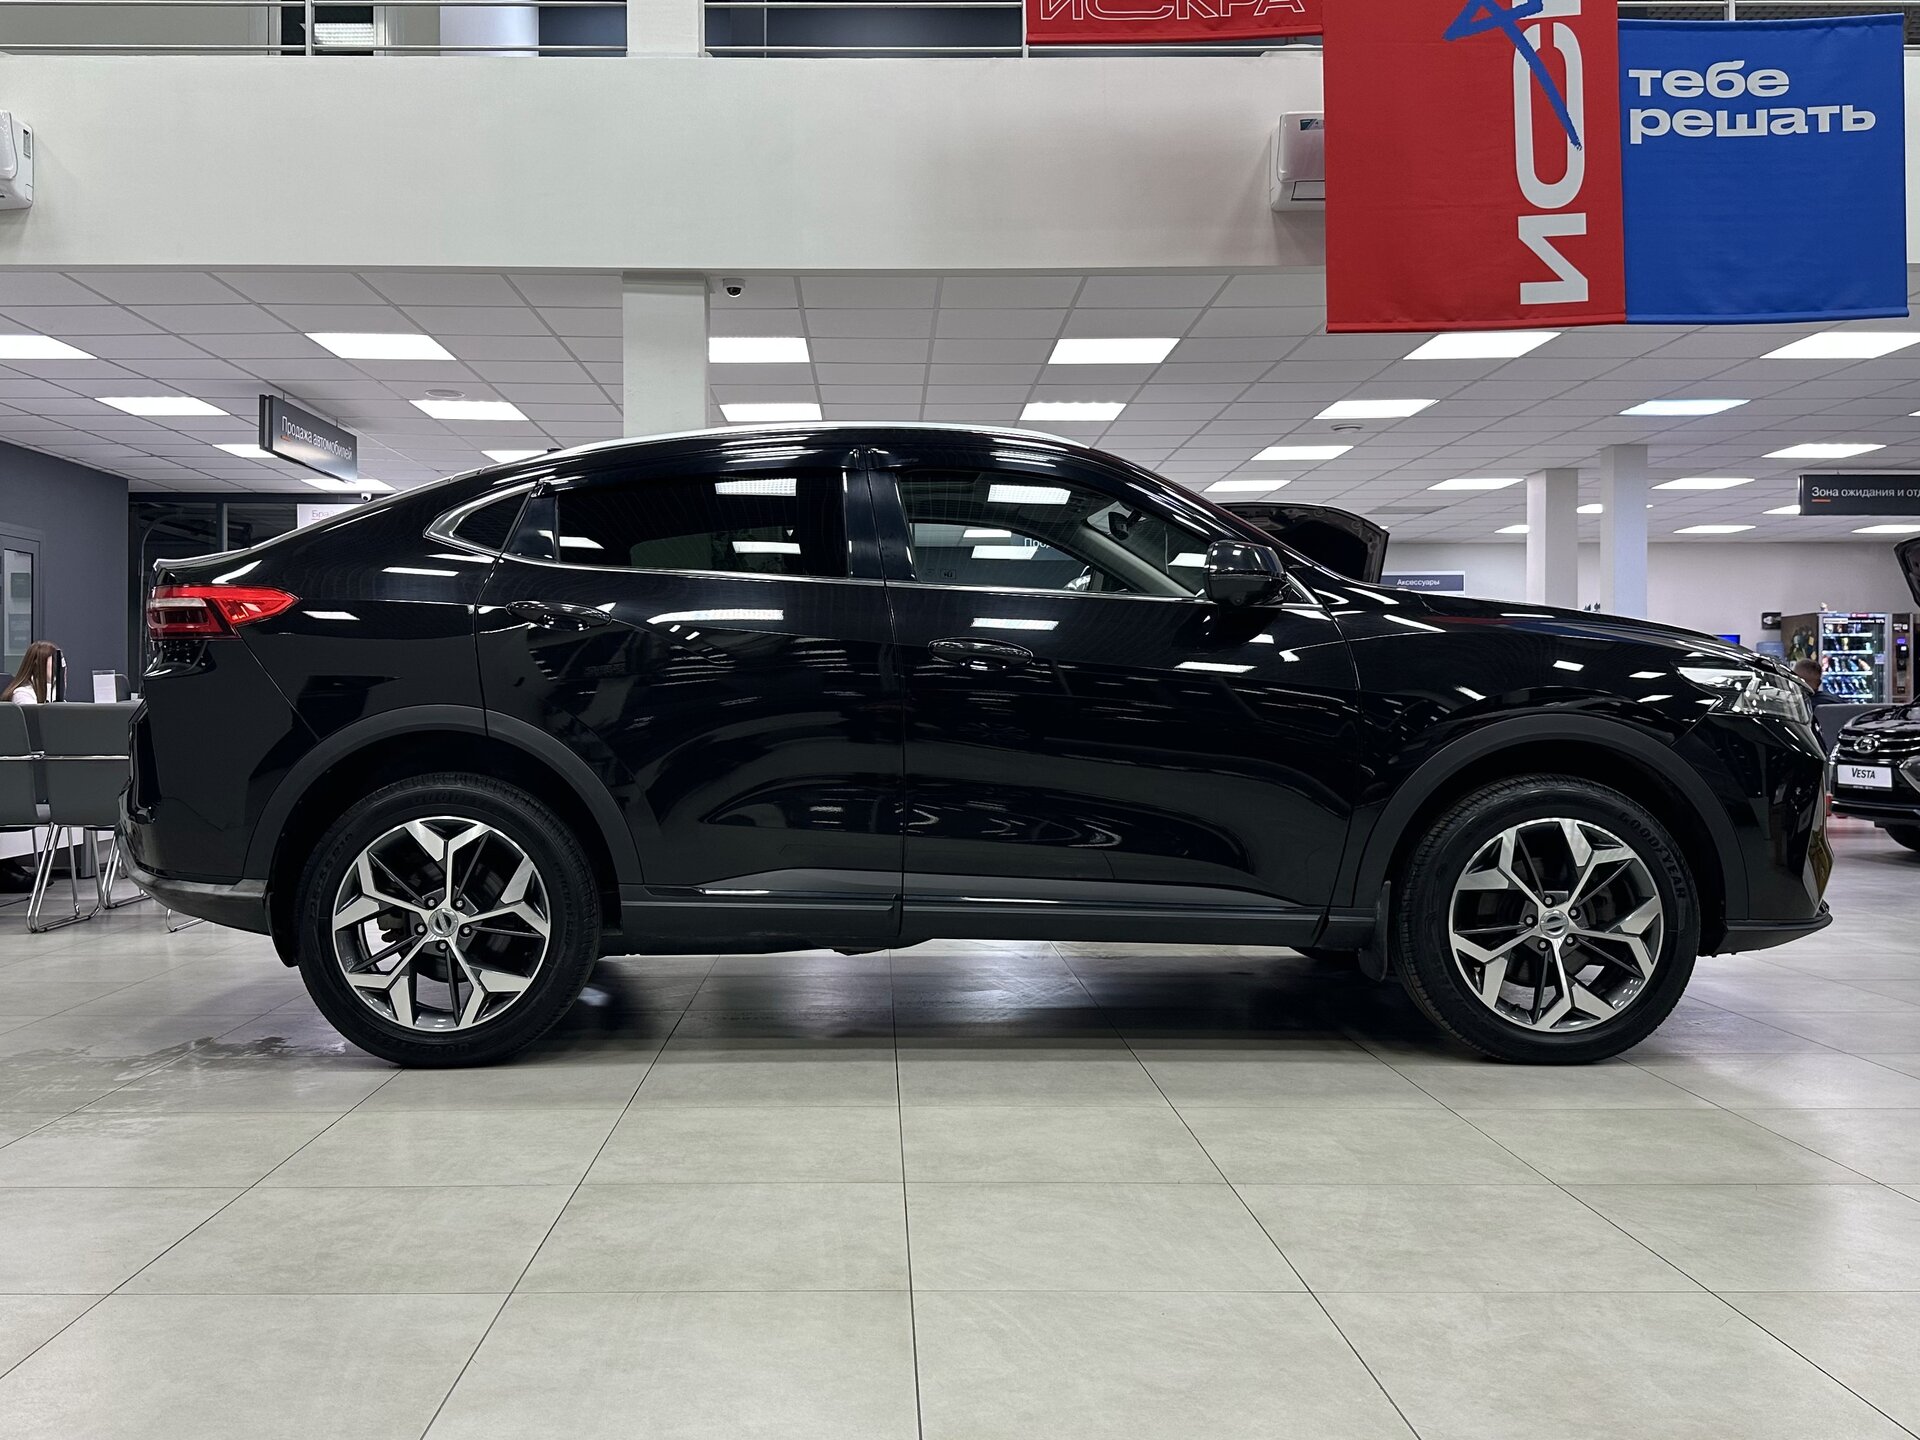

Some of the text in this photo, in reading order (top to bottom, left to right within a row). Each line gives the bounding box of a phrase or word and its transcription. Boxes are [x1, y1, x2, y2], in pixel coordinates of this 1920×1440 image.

[1628, 60, 1790, 98] тебе
[1629, 104, 1876, 144] решать
[1511, 0, 1588, 304] ИС
[281, 415, 353, 461] Продажа автомобилей
[1811, 486, 1839, 497] Зона
[1841, 489, 1895, 498] ожидания
[1897, 489, 1905, 497] и
[1396, 579, 1440, 587] Аксессуары
[1851, 767, 1876, 779] VESTA
[1619, 811, 1688, 899] GOODYEAR
